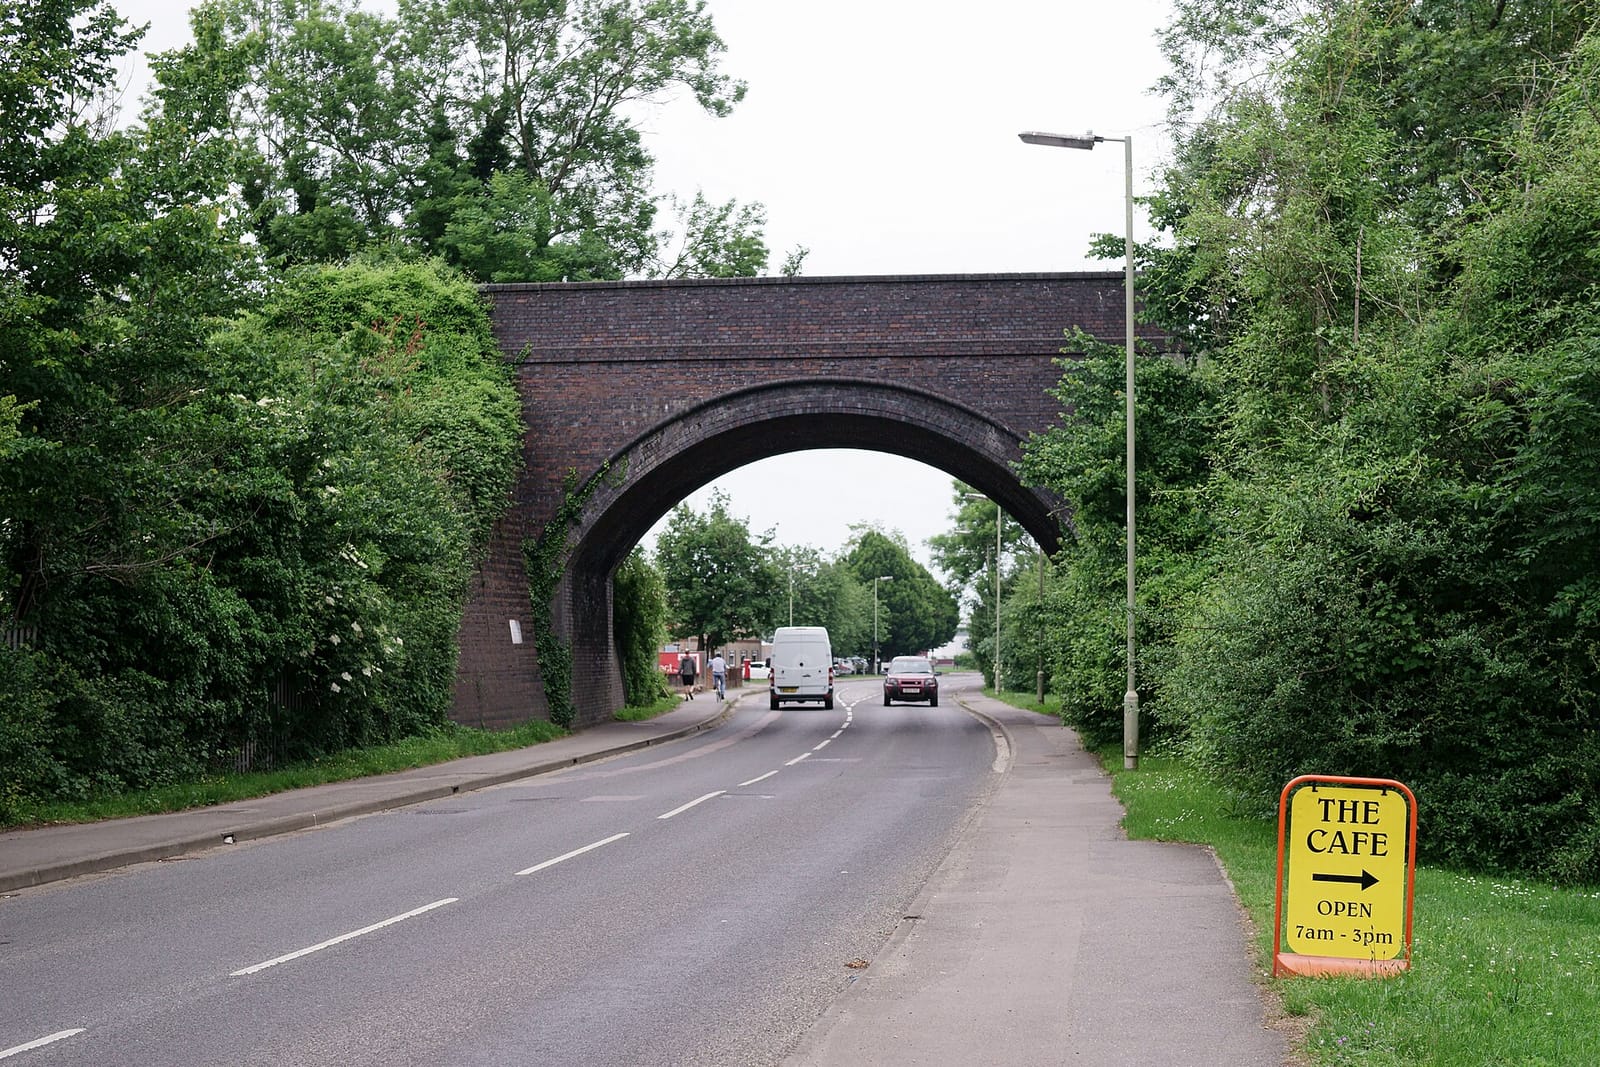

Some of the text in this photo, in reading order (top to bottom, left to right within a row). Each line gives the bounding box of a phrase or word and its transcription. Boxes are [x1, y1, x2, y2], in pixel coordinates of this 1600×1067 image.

[1317, 798, 1380, 825] THE
[1306, 829, 1389, 857] CAFE
[1317, 900, 1373, 918] OPEN
[1295, 925, 1334, 941] 7am
[1352, 928, 1393, 947] 3pm
